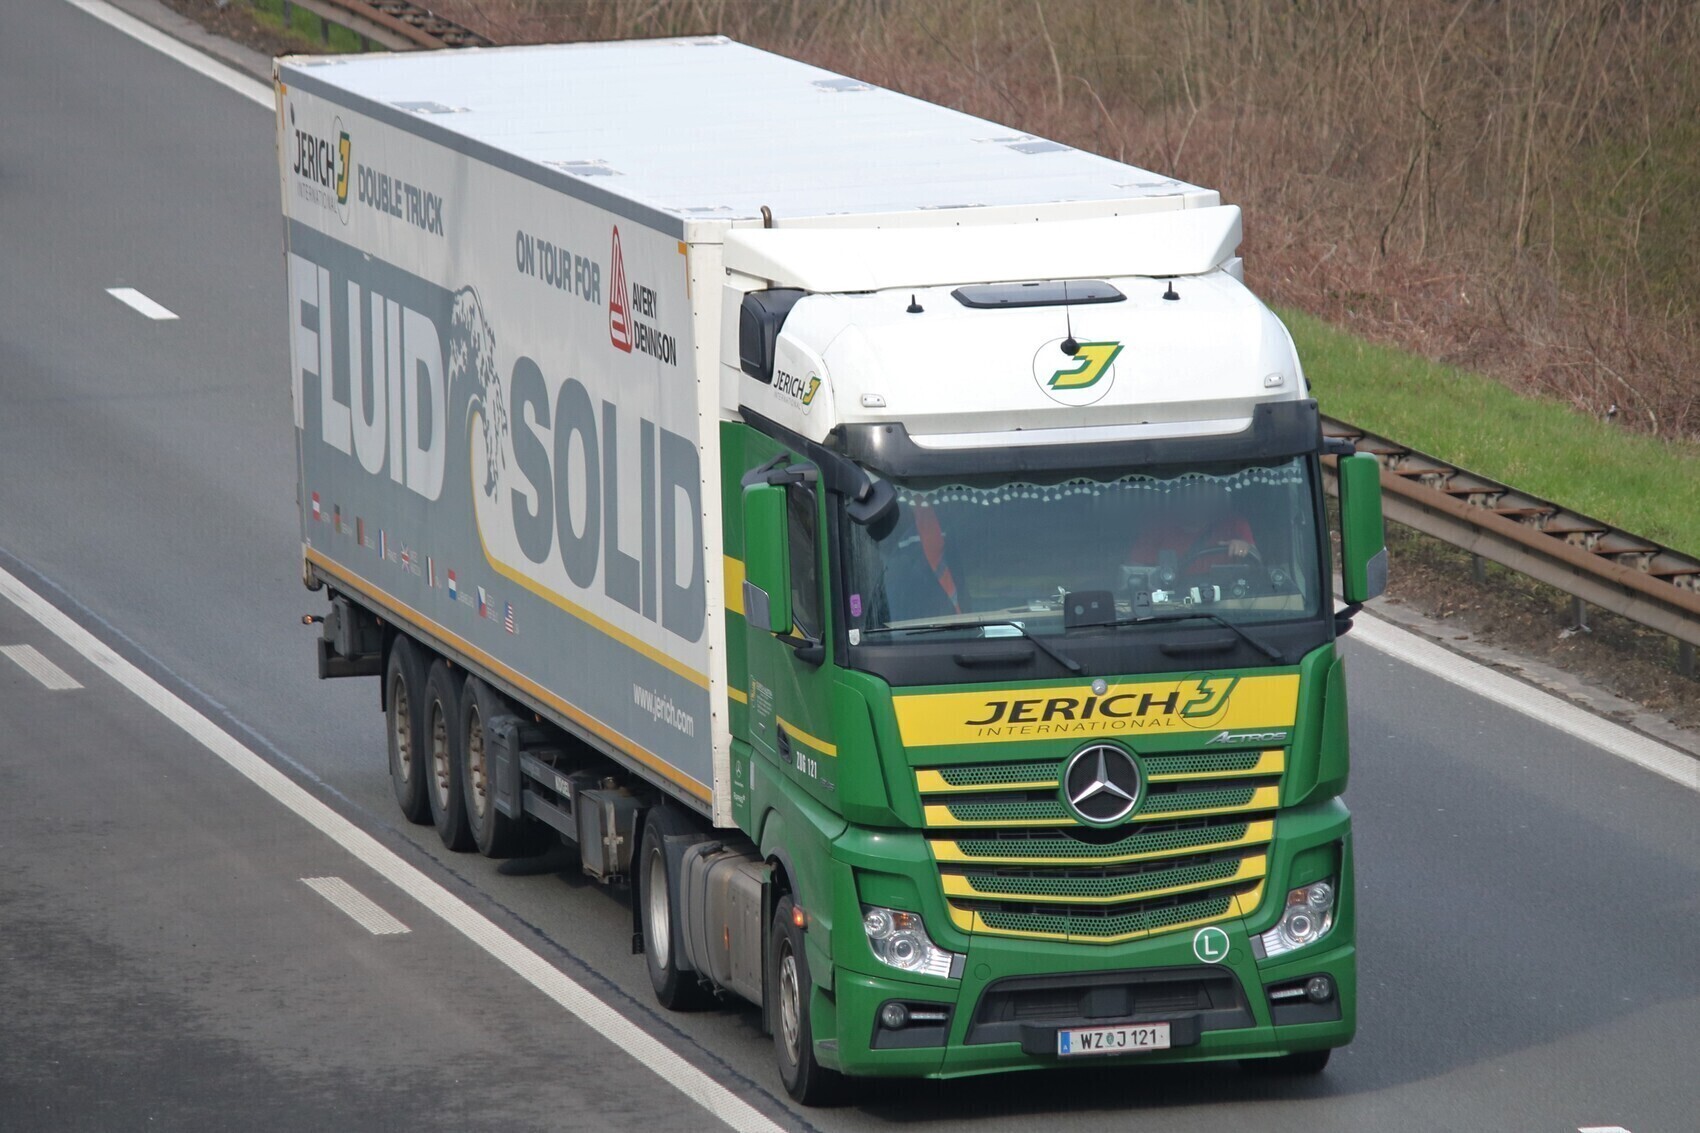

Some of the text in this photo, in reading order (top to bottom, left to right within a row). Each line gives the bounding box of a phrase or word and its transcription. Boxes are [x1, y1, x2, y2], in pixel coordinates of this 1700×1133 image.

[294, 129, 336, 190] JERICH
[357, 163, 444, 236] DOUBLE TRUCK
[516, 229, 601, 305] ON TOUR FOR
[632, 282, 657, 320] AVERY
[633, 320, 677, 367] DENNISON
[287, 250, 446, 501] FLUID
[773, 369, 806, 400] JERICH
[510, 355, 707, 643] SOLID
[633, 683, 694, 738] www.jerich.com
[964, 691, 1181, 725] JERICH
[978, 717, 1176, 736] INTERNATIONAL
[1204, 935, 1218, 956] L
[1081, 1032, 1104, 1049] WZ
